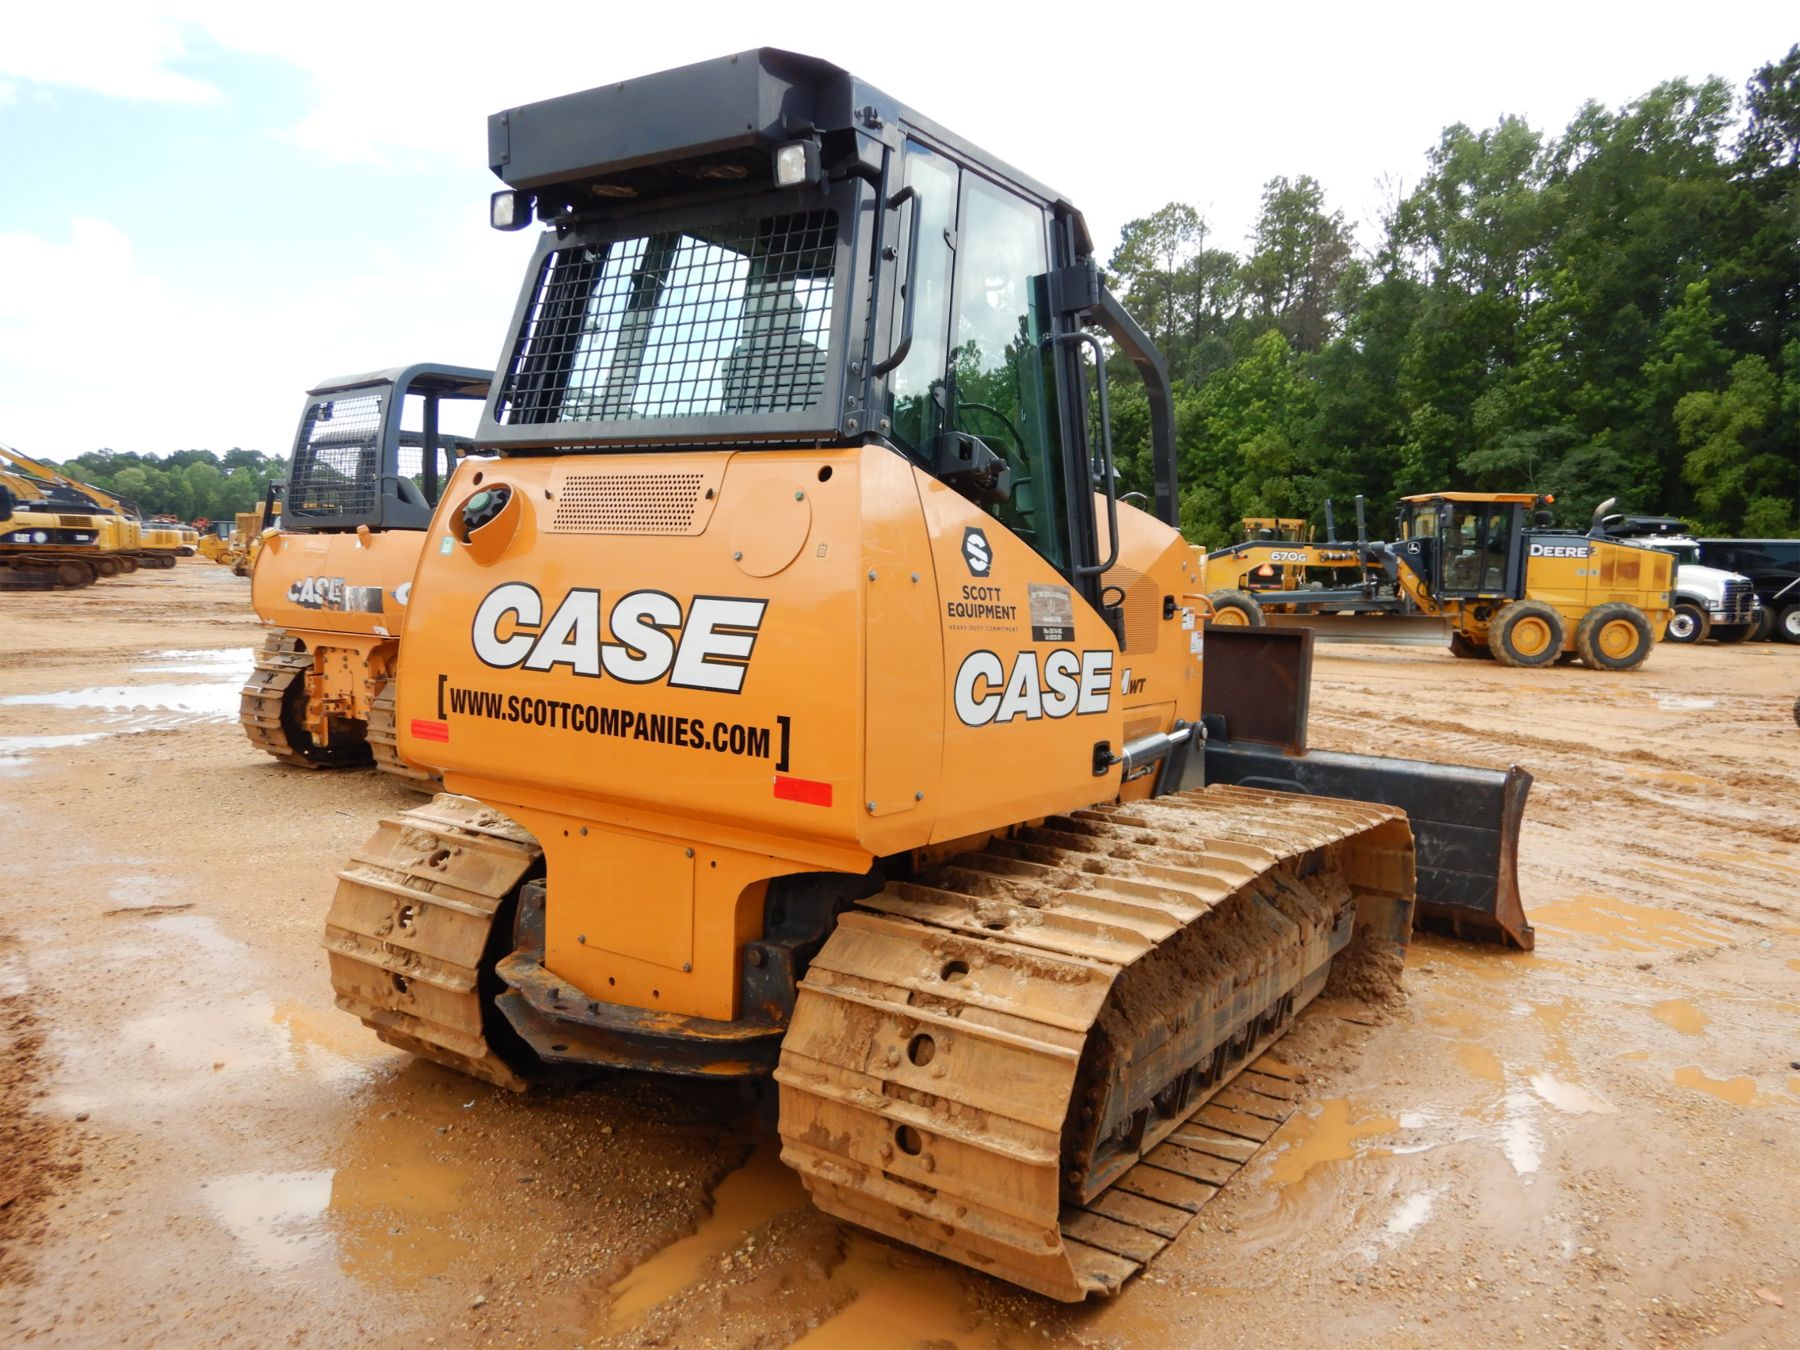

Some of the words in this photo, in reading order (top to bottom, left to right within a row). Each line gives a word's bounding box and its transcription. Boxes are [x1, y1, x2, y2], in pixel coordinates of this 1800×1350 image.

[1271, 551, 1306, 562] 670G
[1530, 543, 1588, 558] DEERE
[287, 576, 345, 610] CASE
[962, 585, 1001, 602] SCOTT
[947, 602, 1017, 620] EQUIPMENT
[471, 581, 770, 695] CASE
[953, 648, 1114, 728] CASE
